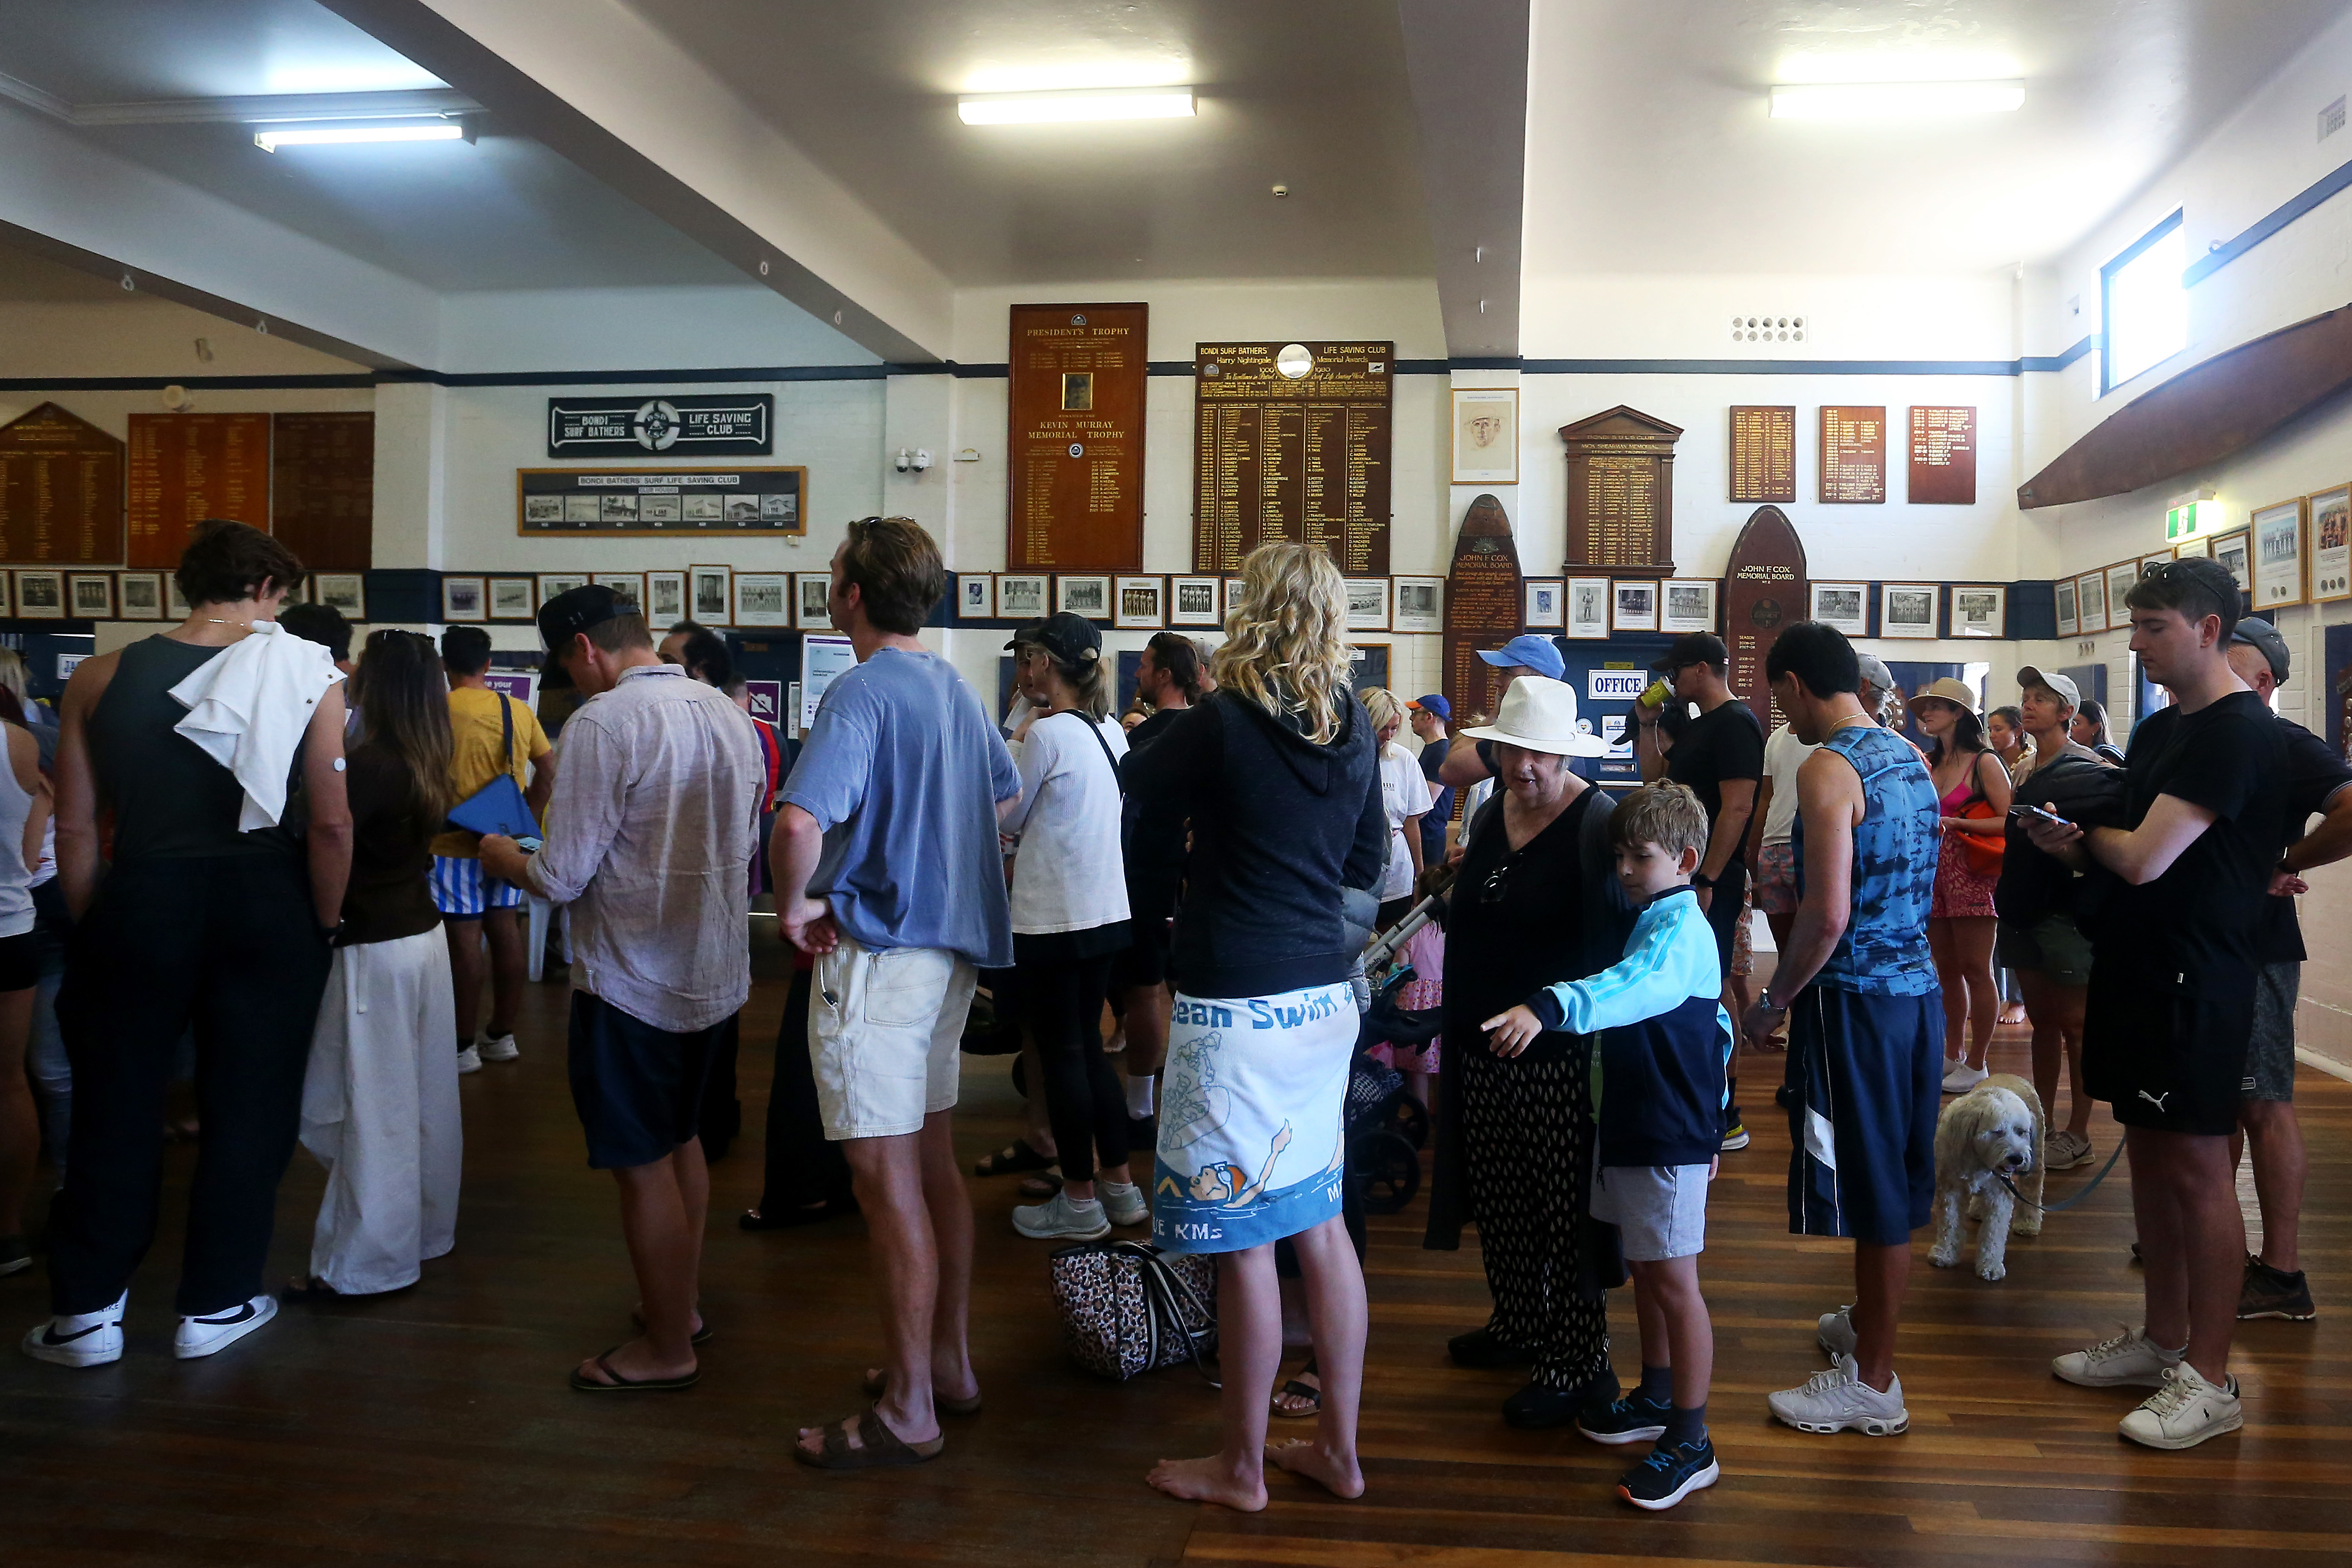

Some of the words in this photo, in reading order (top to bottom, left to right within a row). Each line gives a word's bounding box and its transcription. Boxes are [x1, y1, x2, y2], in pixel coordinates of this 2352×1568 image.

[582, 416, 608, 426] BONDI
[689, 414, 709, 424] LIFE
[712, 413, 751, 423] SAVING
[564, 427, 583, 437] SURF
[588, 426, 625, 437] BATHERS
[707, 425, 733, 435] CLUB
[1595, 678, 1641, 692] OFFICE
[1172, 1000, 1232, 1028] ean
[1248, 993, 1338, 1029] Swim
[1175, 1223, 1223, 1240] KMs
